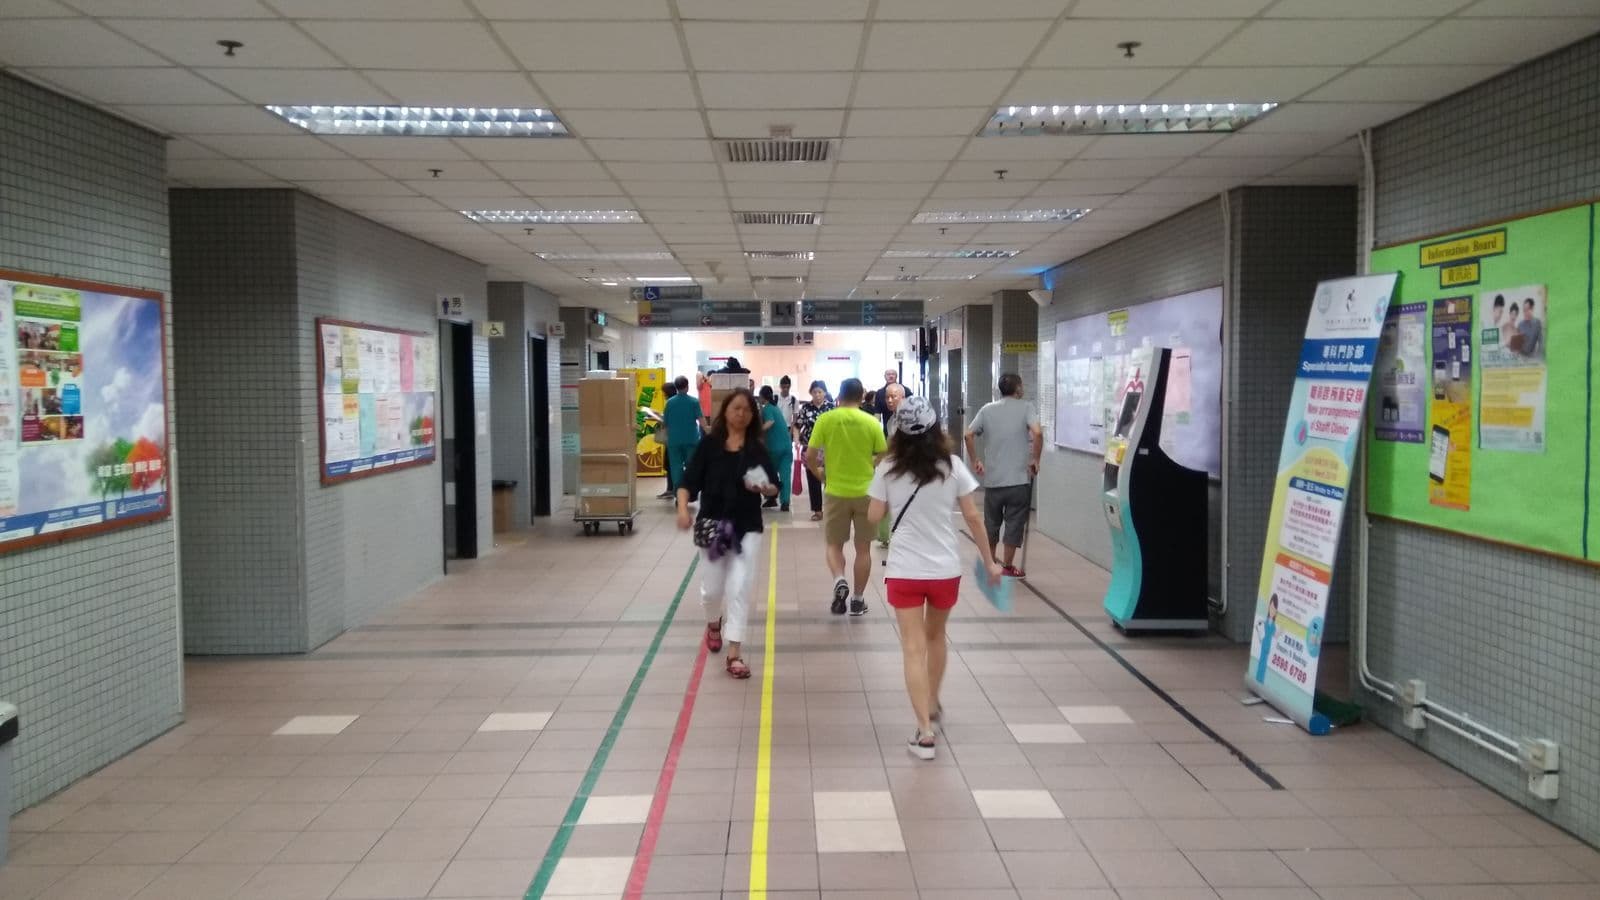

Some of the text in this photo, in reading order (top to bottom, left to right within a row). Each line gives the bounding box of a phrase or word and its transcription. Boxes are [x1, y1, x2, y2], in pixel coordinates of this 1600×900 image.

[1427, 236, 1497, 261] Information Board
[452, 297, 462, 308] 男
[1316, 420, 1330, 432] Staff
[1330, 422, 1350, 435] Clinic
